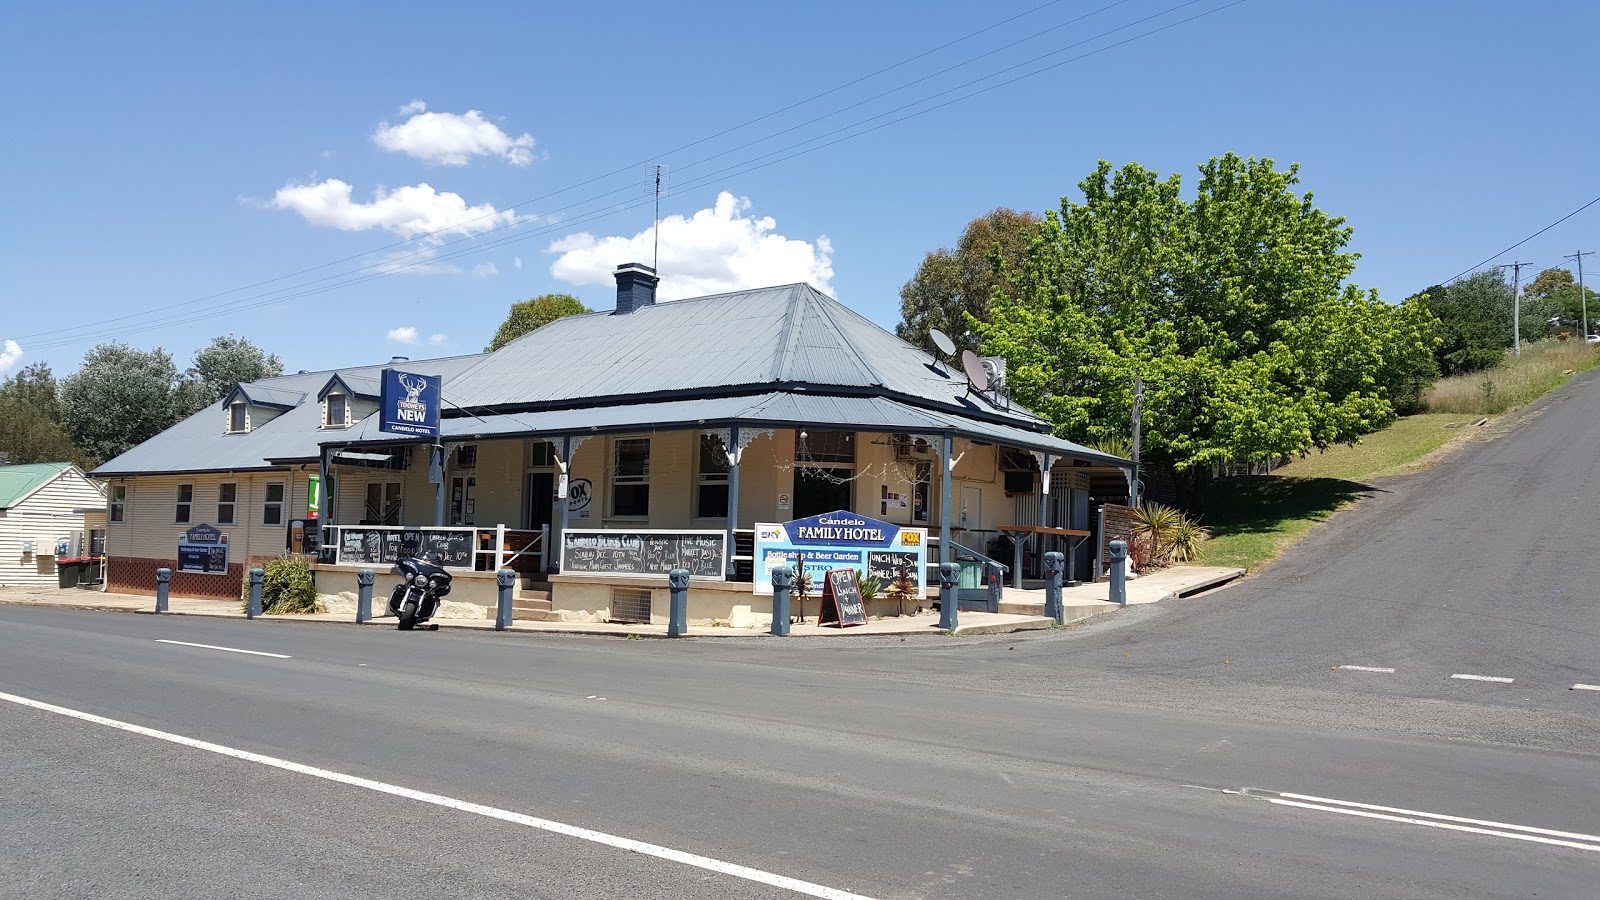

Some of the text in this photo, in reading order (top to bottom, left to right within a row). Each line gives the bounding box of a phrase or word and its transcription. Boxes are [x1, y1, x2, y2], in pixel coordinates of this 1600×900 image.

[397, 408, 426, 422] NEW
[391, 425, 415, 433] CANDELO
[569, 482, 588, 499] OX
[818, 517, 865, 526] Candelo
[403, 533, 420, 542] OPEN
[798, 526, 885, 541] FAMILY HOTEL
[902, 532, 920, 542] FOX
[622, 535, 640, 548] CLUB
[695, 536, 717, 547] MUSIC
[815, 552, 832, 560] Beer
